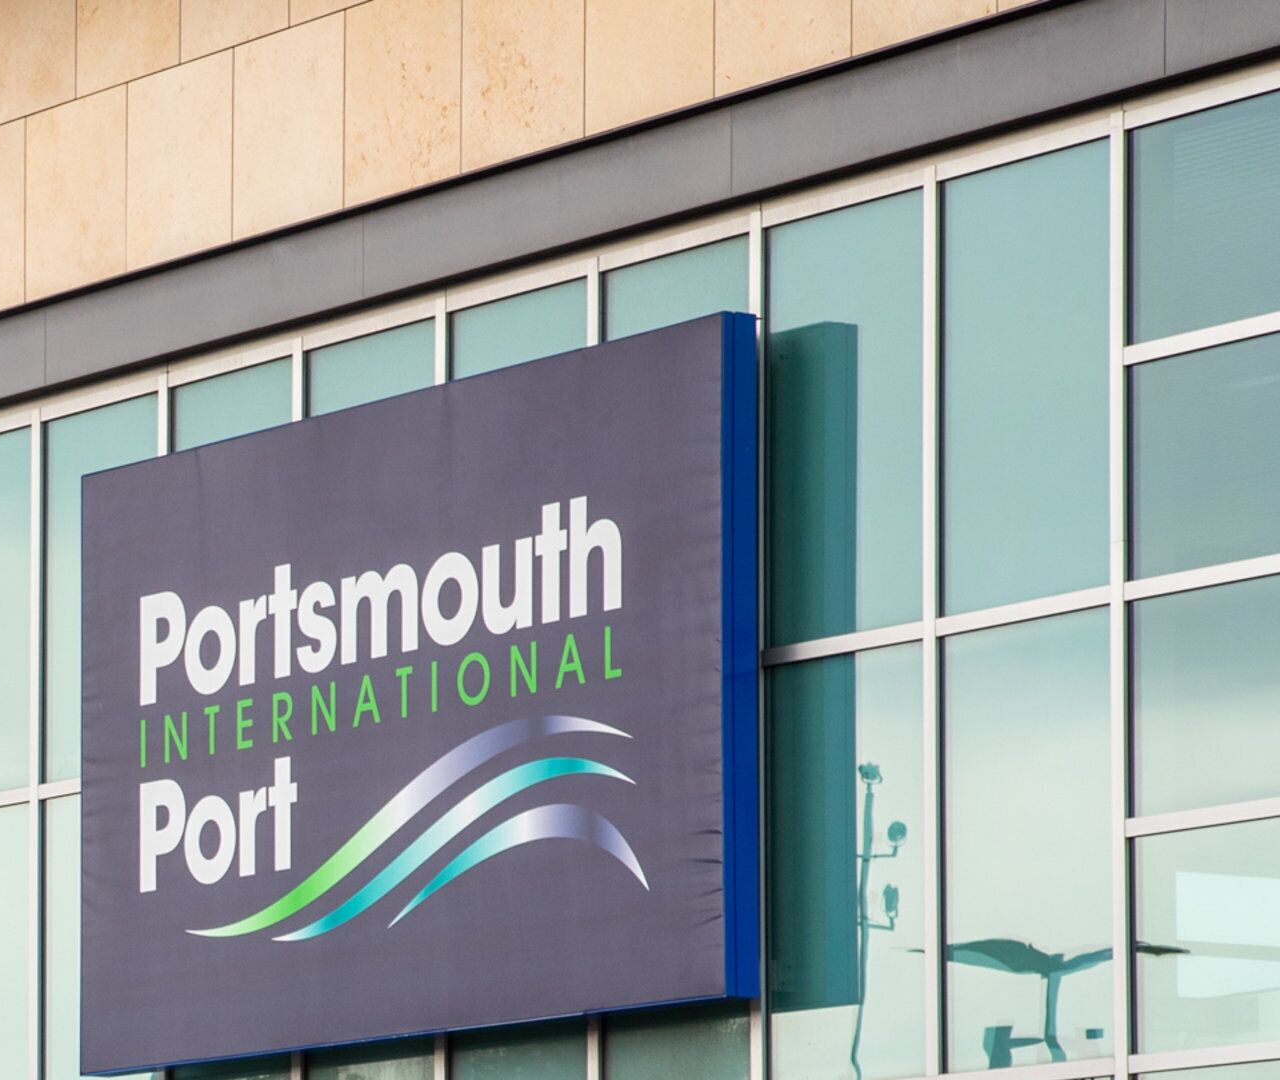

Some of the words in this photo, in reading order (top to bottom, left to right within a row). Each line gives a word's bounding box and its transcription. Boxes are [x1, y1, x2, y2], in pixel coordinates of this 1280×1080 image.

[140, 495, 622, 706] Portsmouth
[140, 626, 622, 768] INTERNATIONAL
[140, 757, 298, 893] Port
